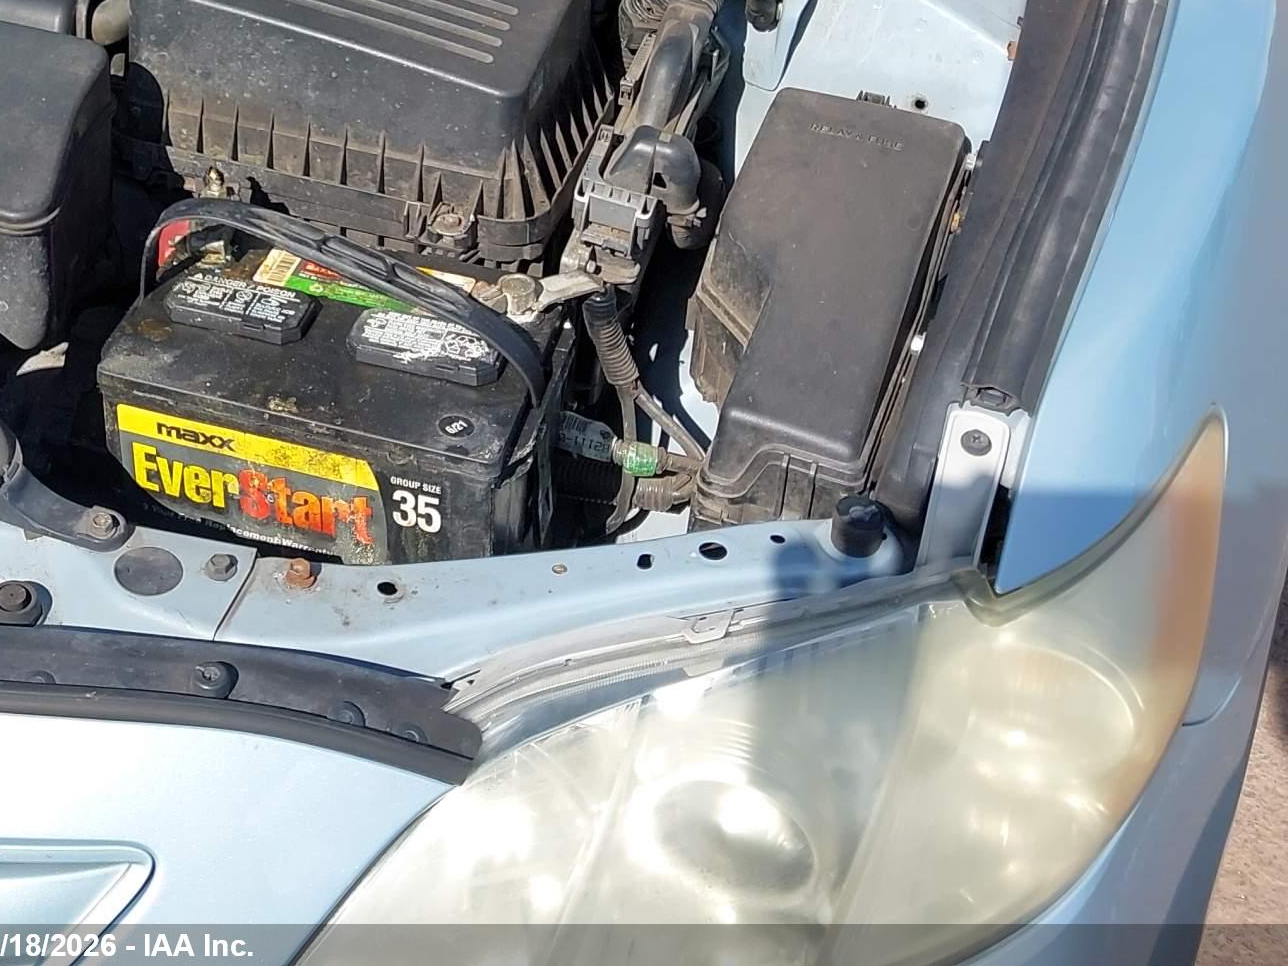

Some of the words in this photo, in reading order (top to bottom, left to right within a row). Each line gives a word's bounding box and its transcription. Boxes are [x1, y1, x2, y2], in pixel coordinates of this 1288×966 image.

[809, 122, 852, 138] RELAY
[868, 135, 903, 151] FUSE
[204, 274, 247, 288] DANGER
[256, 285, 297, 298] POISON
[156, 421, 236, 452] maxx
[445, 420, 468, 434] 6/21
[132, 441, 375, 546] EverStart
[390, 476, 421, 490] GROUP
[422, 483, 442, 494] SIZE
[392, 489, 442, 533] 35
